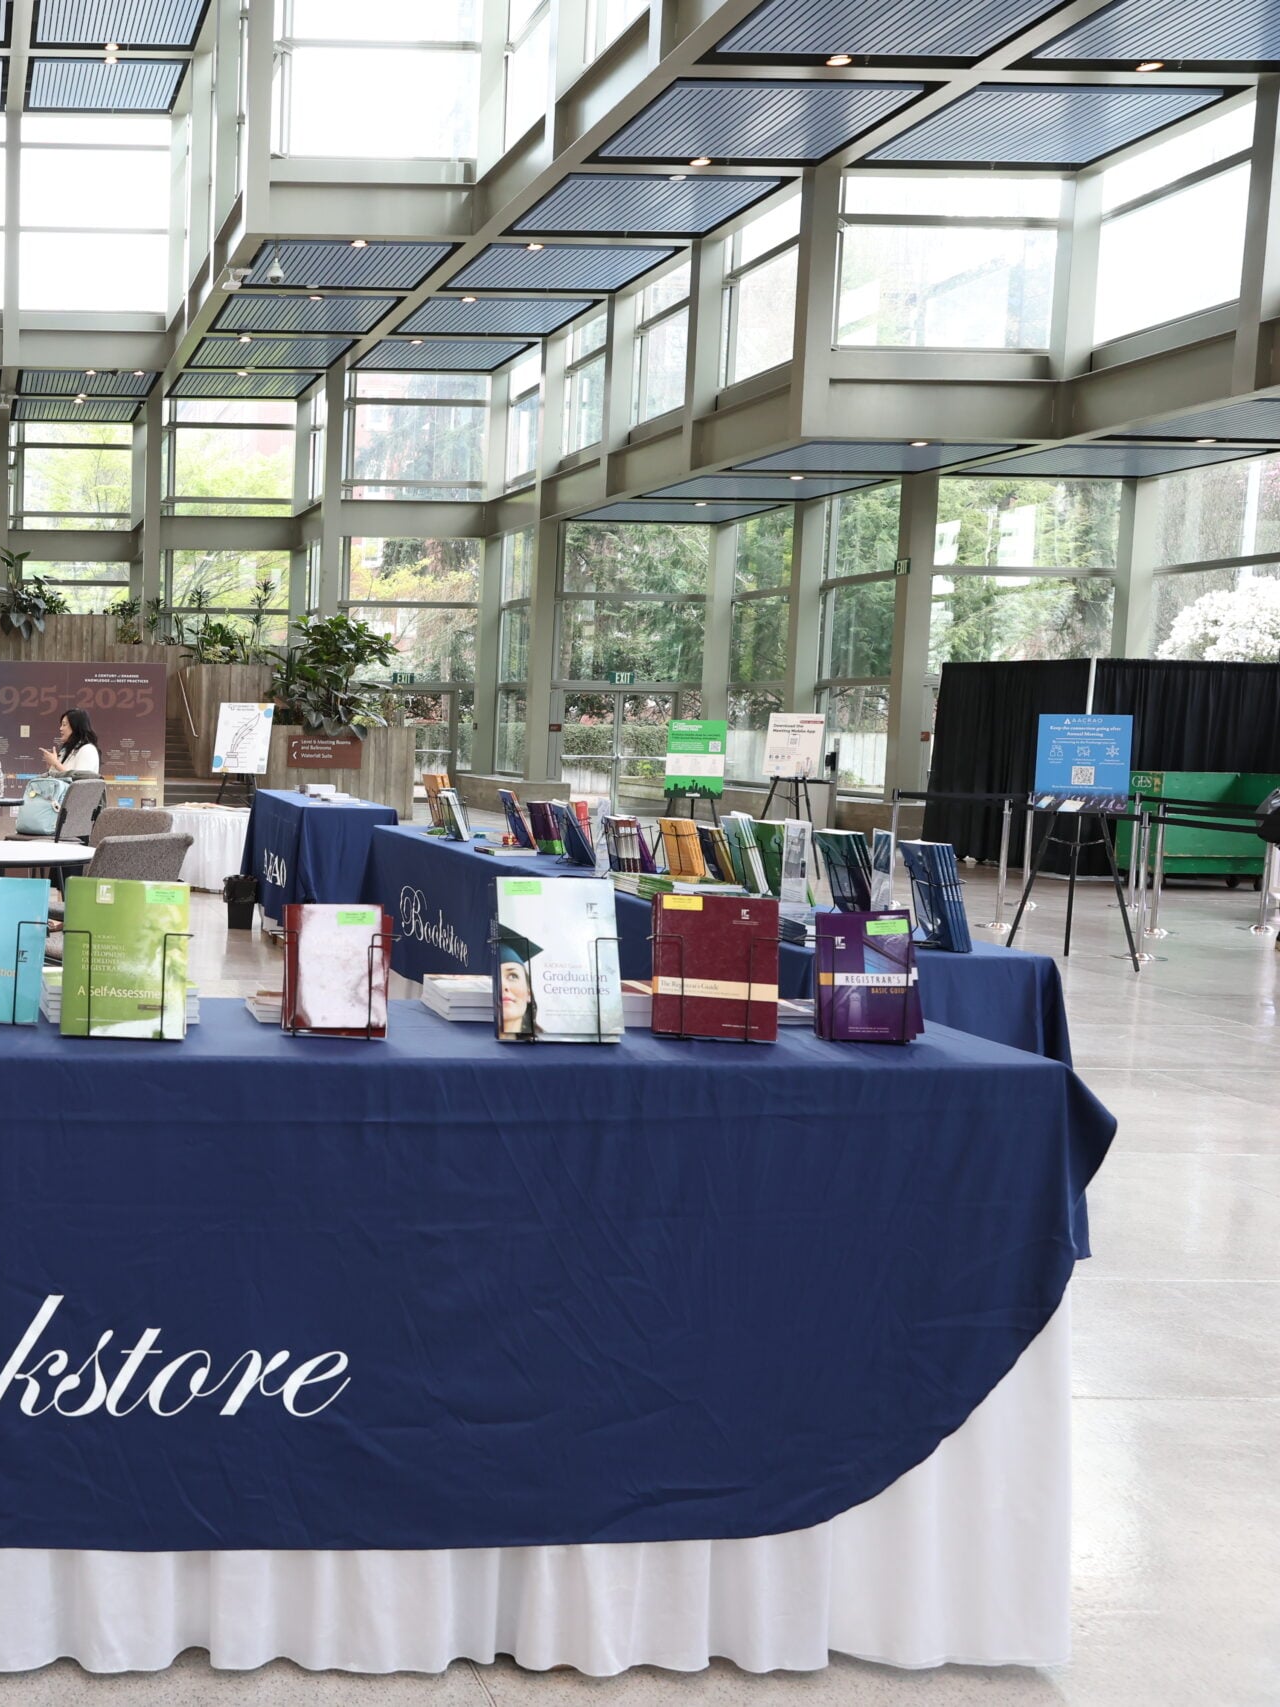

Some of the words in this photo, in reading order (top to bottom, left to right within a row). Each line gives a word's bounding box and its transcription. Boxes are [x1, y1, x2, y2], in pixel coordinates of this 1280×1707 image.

[397, 673, 411, 684] EXIT
[615, 672, 630, 684] EXIT
[400, 886, 470, 968] Bookstore
[542, 970, 608, 982] Graduatin
[845, 975, 901, 984] REGISTRAR'S
[77, 985, 86, 996] A
[543, 983, 610, 995] Ceremones
[871, 986, 889, 994] BASIC
